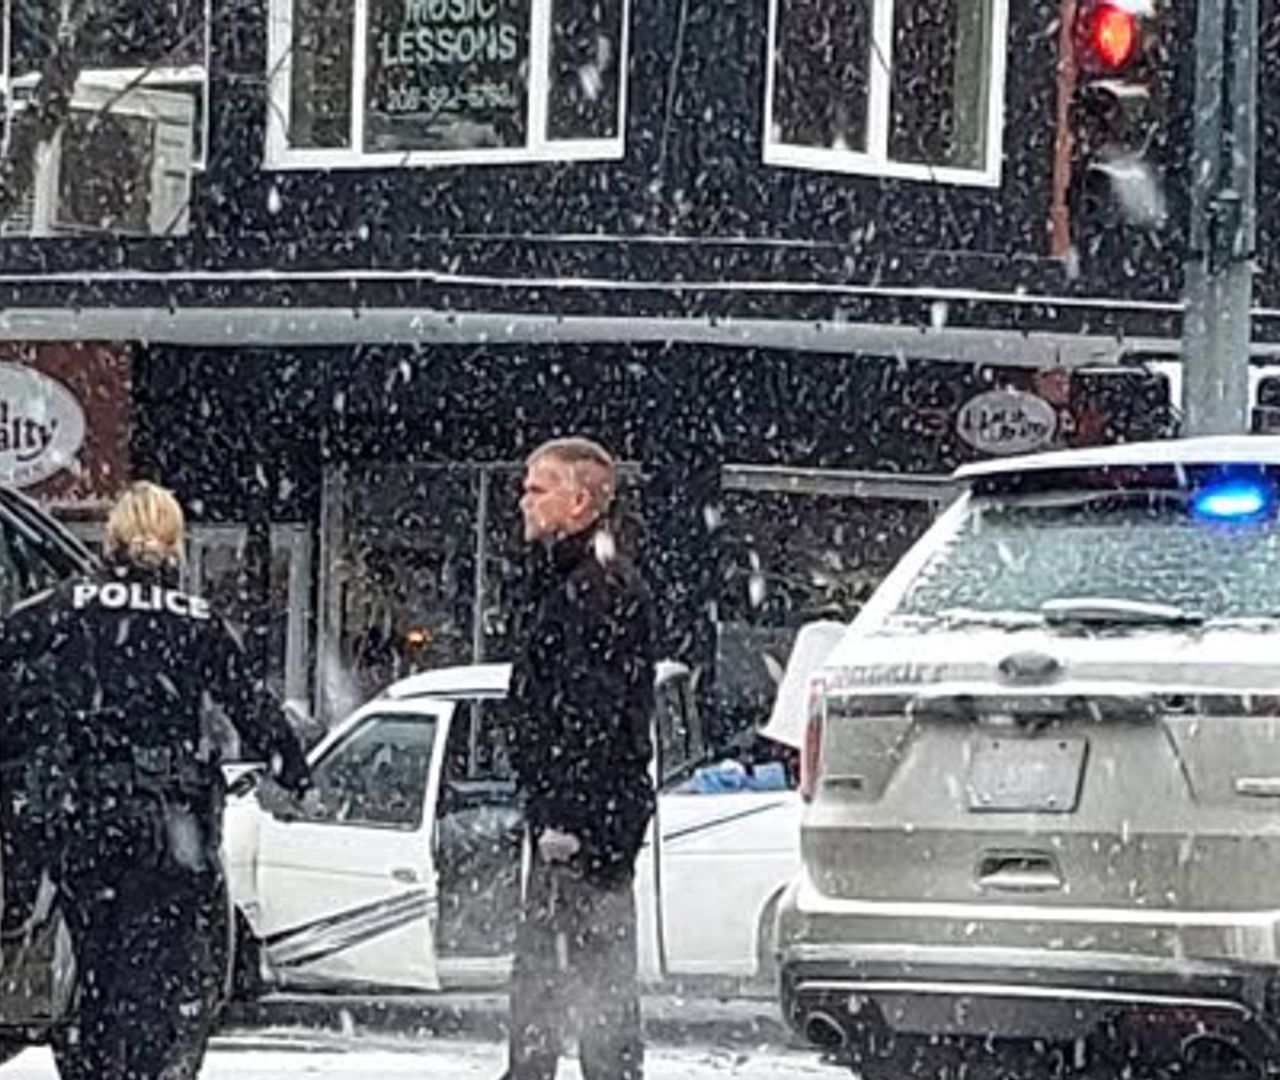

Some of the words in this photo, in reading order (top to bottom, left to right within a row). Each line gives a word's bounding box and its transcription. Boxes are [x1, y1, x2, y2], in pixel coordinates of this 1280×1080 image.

[404, 0, 497, 20] MUSIC
[381, 24, 517, 66] LESSONS
[72, 582, 211, 619] POLICE
